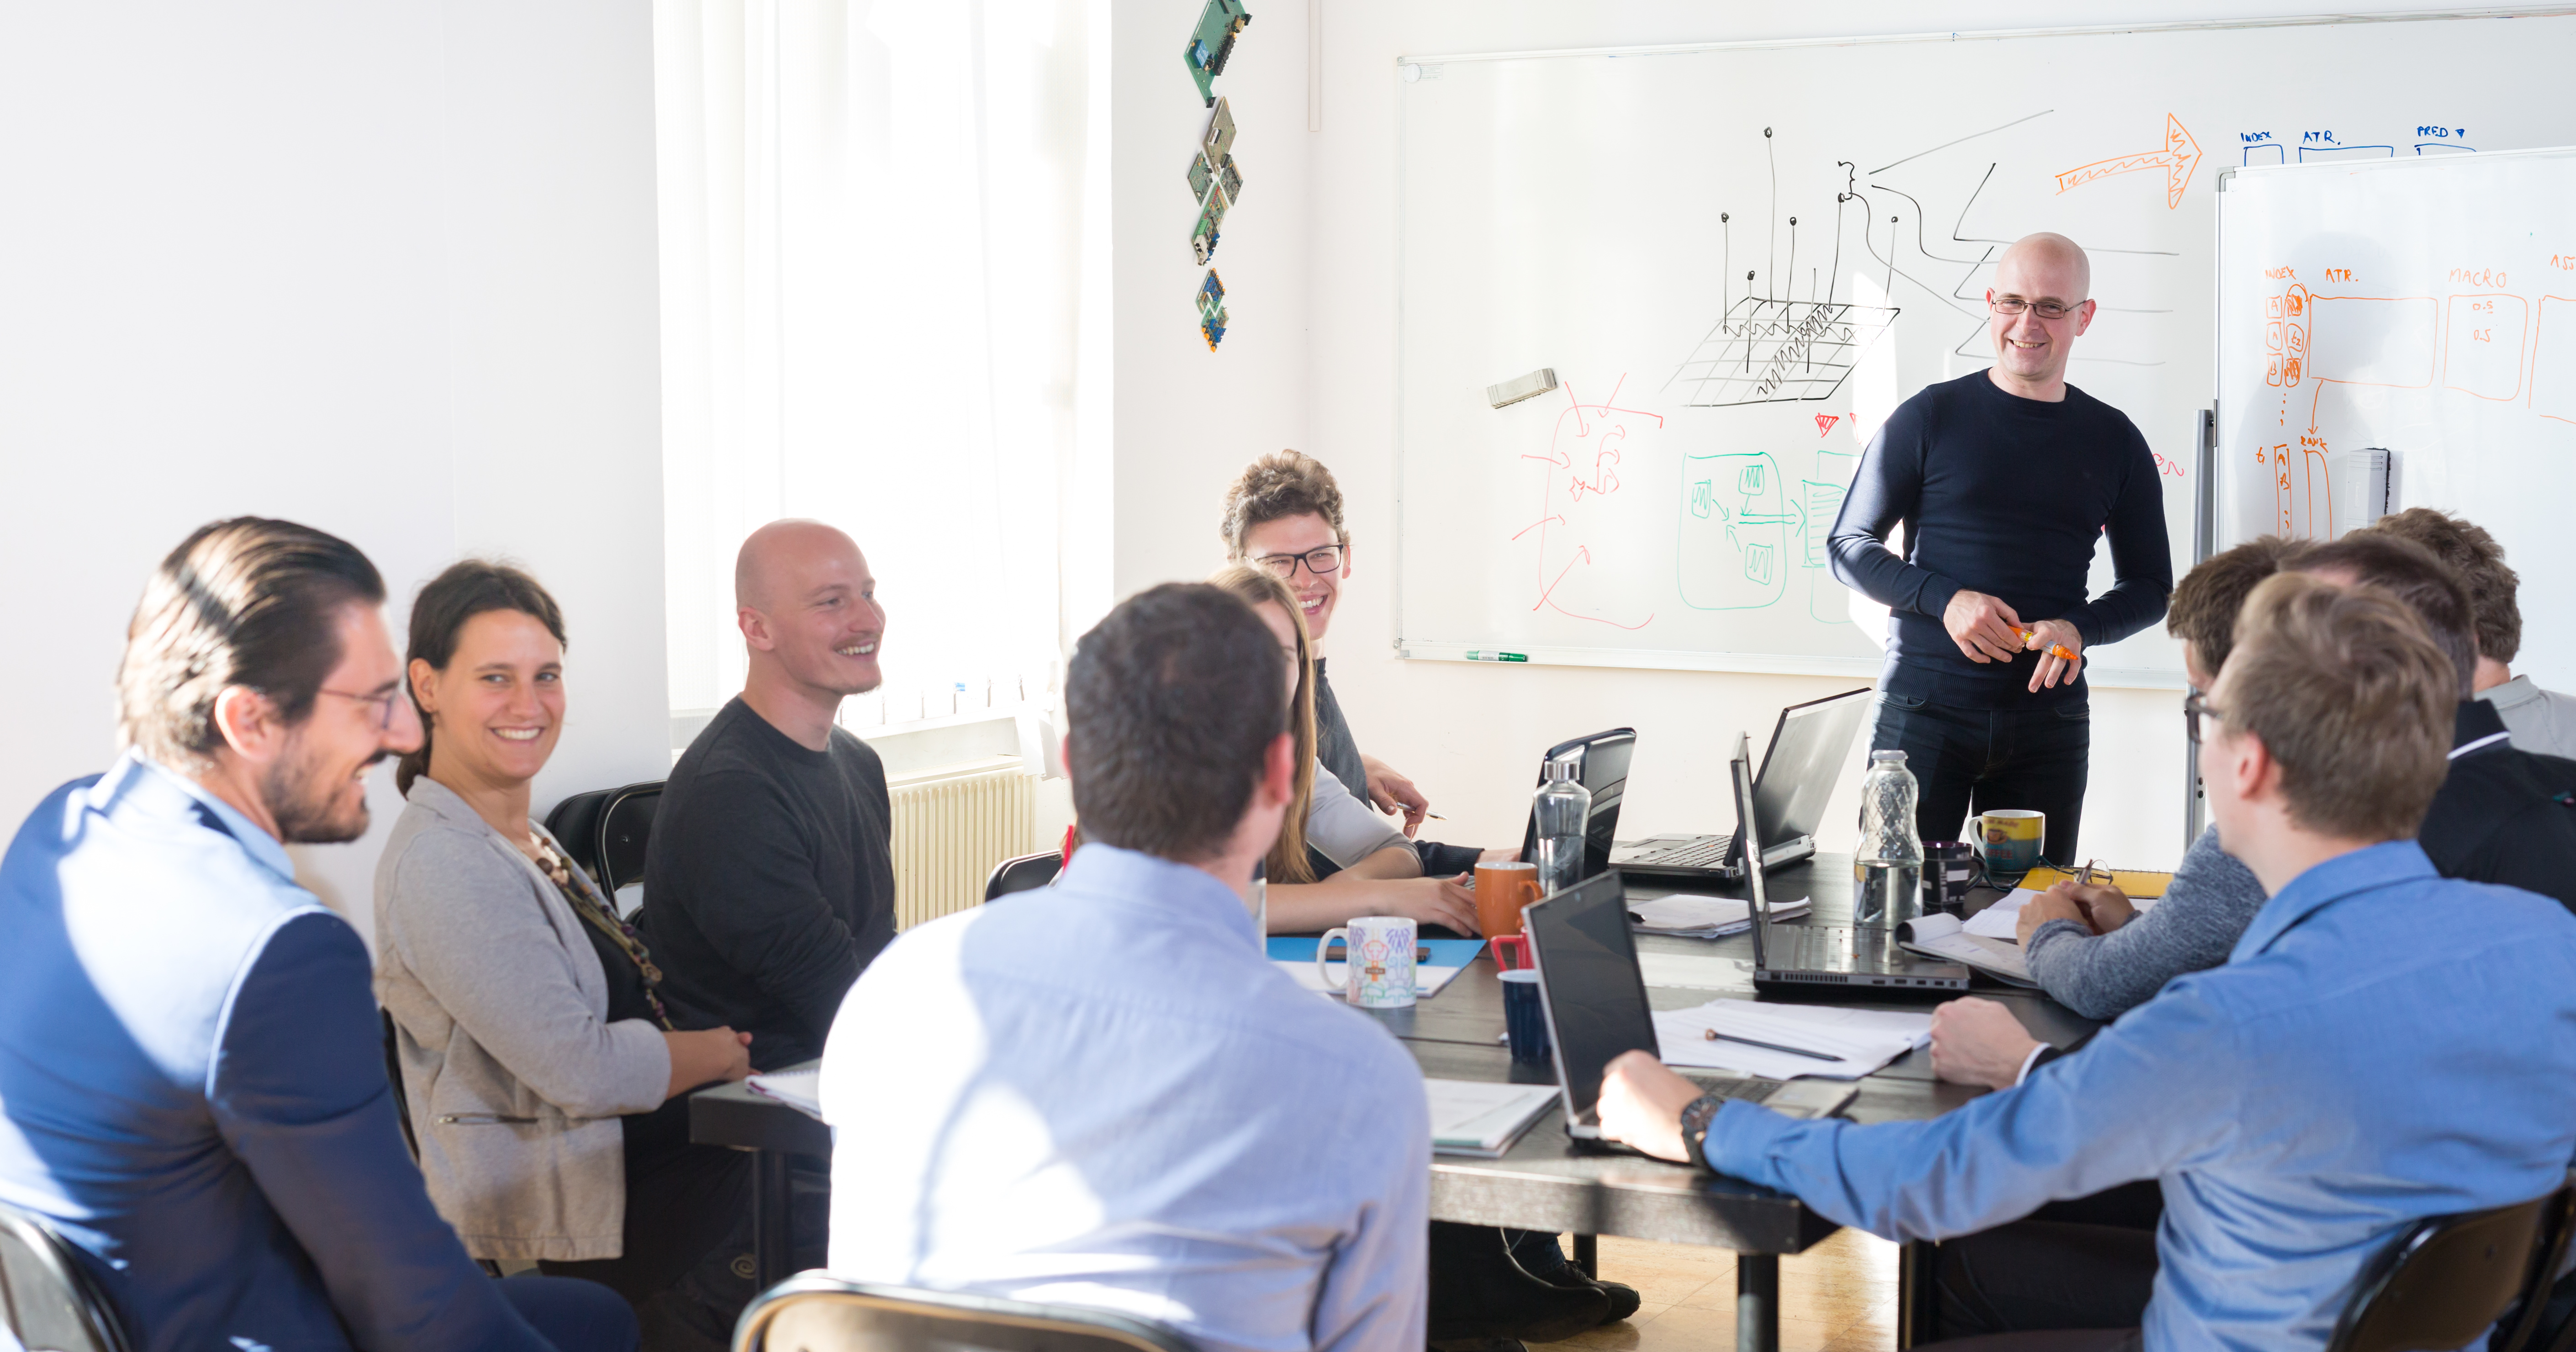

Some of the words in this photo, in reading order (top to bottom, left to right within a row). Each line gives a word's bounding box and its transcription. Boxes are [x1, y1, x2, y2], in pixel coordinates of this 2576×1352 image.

[2241, 131, 2272, 142] INDEX
[2303, 130, 2341, 145] ATR.
[2417, 126, 2449, 137] PRED
[2265, 265, 2296, 280] INDEX
[2326, 268, 2359, 283] ATR.
[2449, 268, 2507, 288] MACRO
[2271, 300, 2278, 312] A
[2472, 300, 2493, 311] 0.5
[2474, 328, 2491, 343] 0.5
[2270, 360, 2277, 375] B
[1985, 847, 2013, 859] OFFEE
